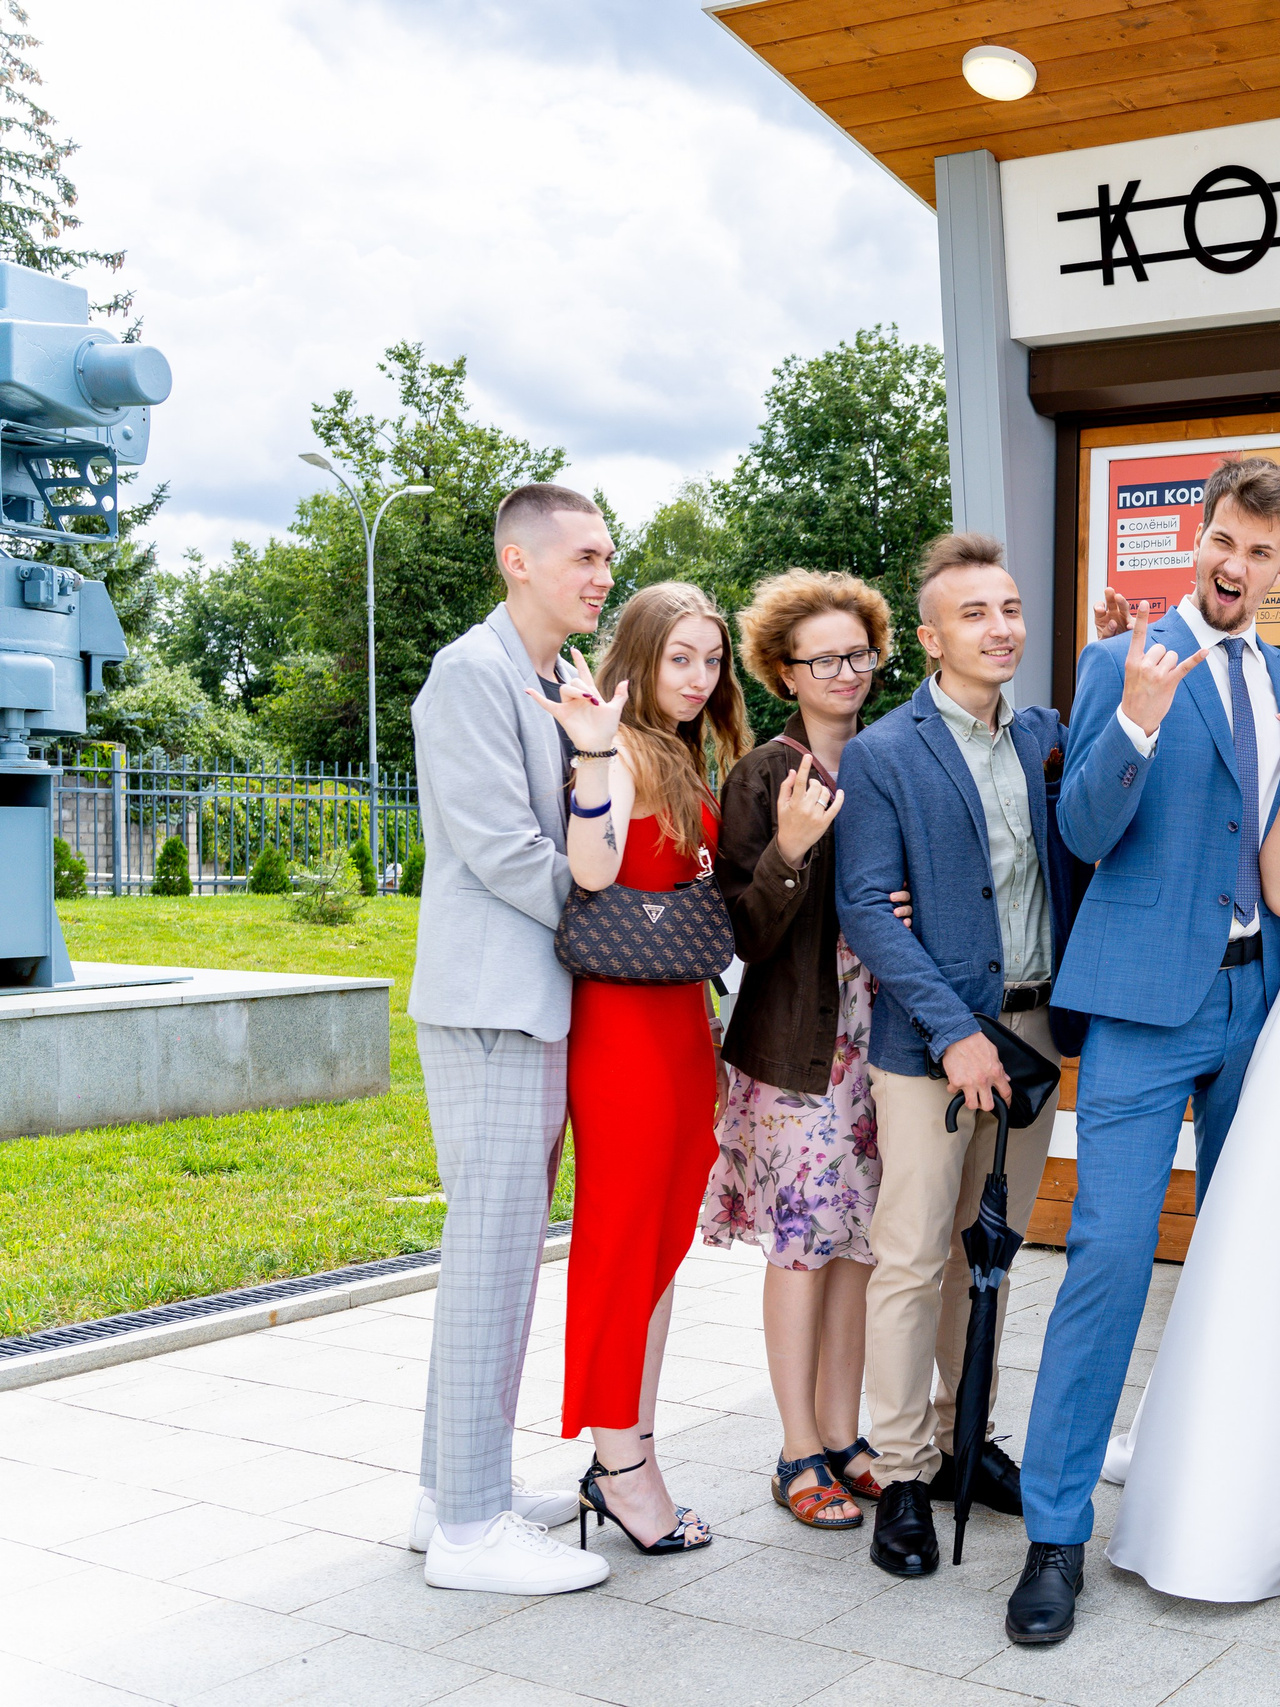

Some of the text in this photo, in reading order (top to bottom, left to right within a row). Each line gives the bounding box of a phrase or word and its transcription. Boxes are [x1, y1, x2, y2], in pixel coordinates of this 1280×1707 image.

[1118, 486, 1204, 508] поп кор
[1128, 517, 1178, 532] солёный
[1128, 536, 1172, 551] сырный
[1128, 553, 1191, 569] фруктовый
